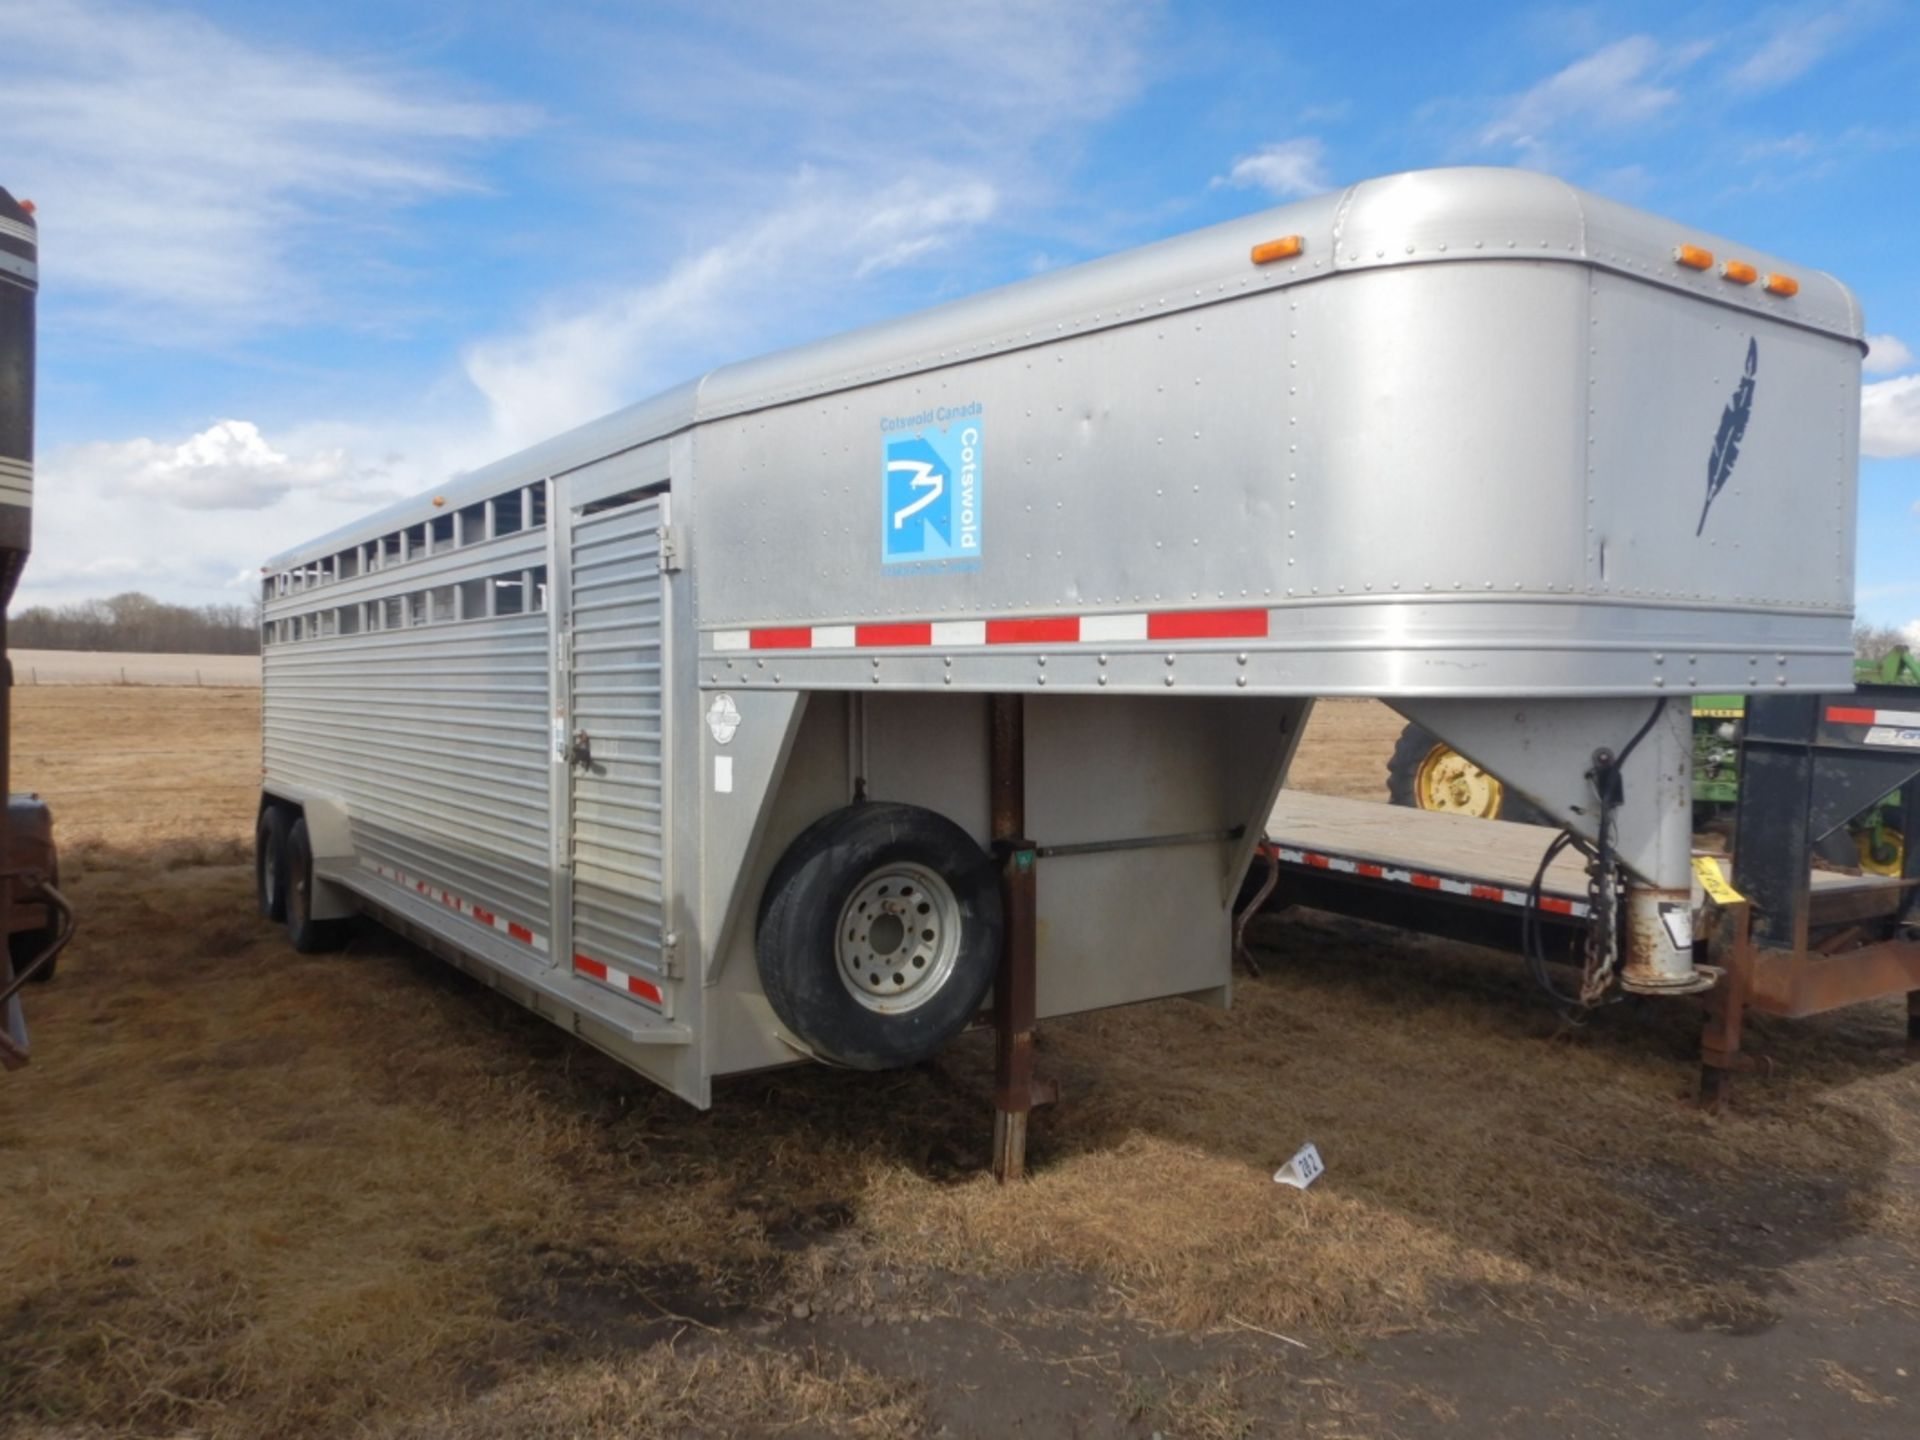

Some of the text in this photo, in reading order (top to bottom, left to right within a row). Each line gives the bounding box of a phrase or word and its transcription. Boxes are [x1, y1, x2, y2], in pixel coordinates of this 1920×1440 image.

[880, 401, 983, 432] Cotswold Canada
[960, 427, 978, 548] Cotswold
